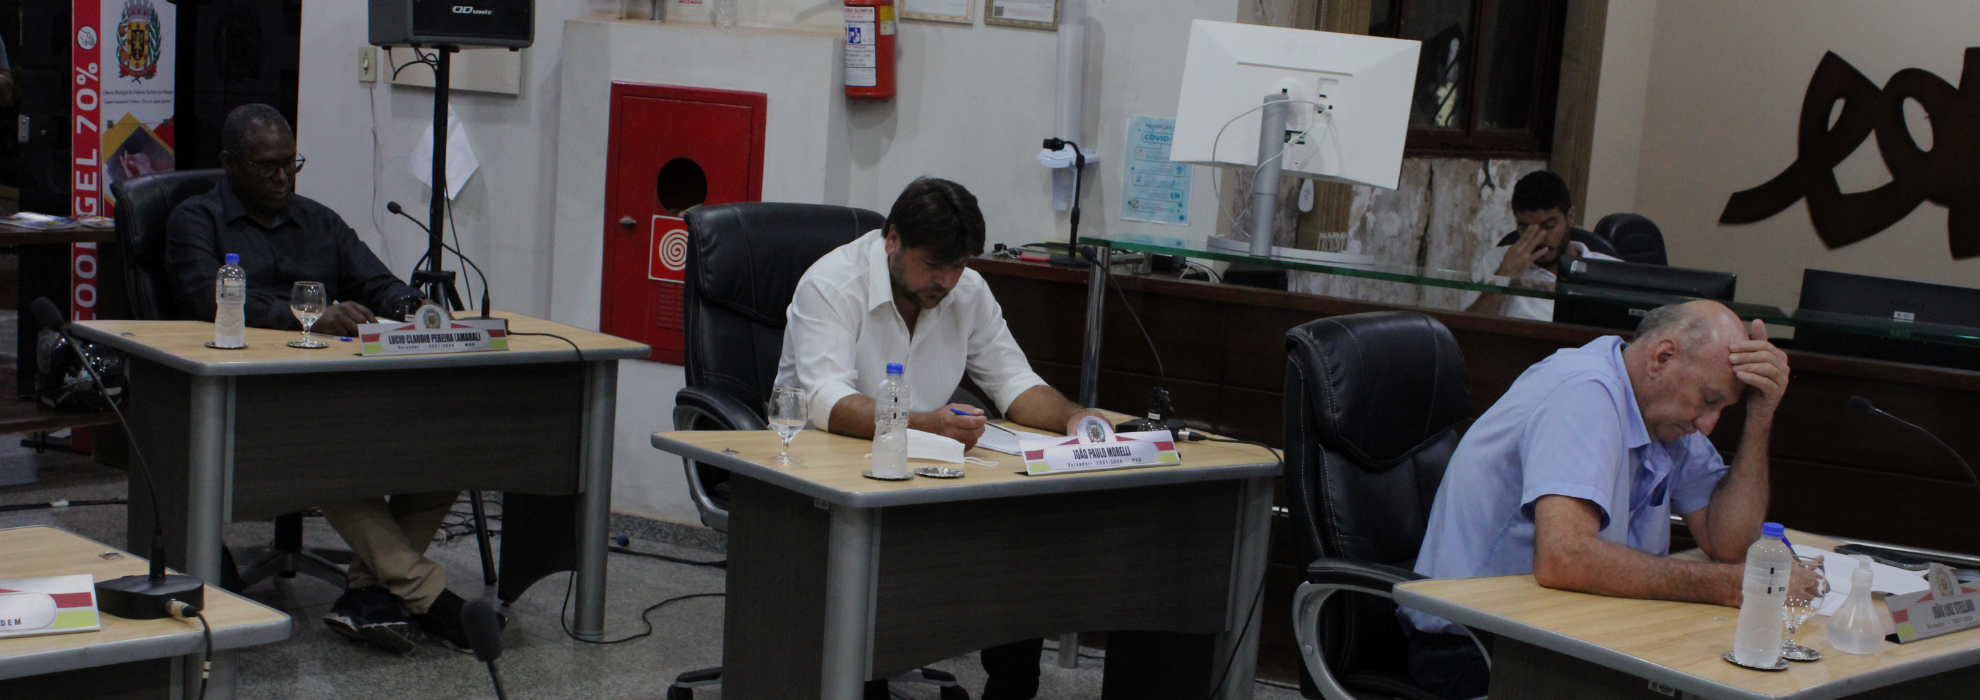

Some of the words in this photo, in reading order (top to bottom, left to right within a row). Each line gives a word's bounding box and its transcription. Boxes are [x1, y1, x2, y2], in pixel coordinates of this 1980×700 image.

[1299, 42, 1319, 56] LG
[75, 62, 99, 134] 70%
[1144, 133, 1174, 142] COVID-
[75, 149, 98, 216] GEL
[388, 334, 406, 345] LUCIO
[430, 332, 454, 343] PEREIRA
[454, 332, 481, 342] (AMARAL)
[1073, 447, 1089, 460] JOÃO
[1088, 447, 1107, 459] PAULO
[1106, 446, 1131, 458] MORELLI
[0, 618, 22, 626] DEM
